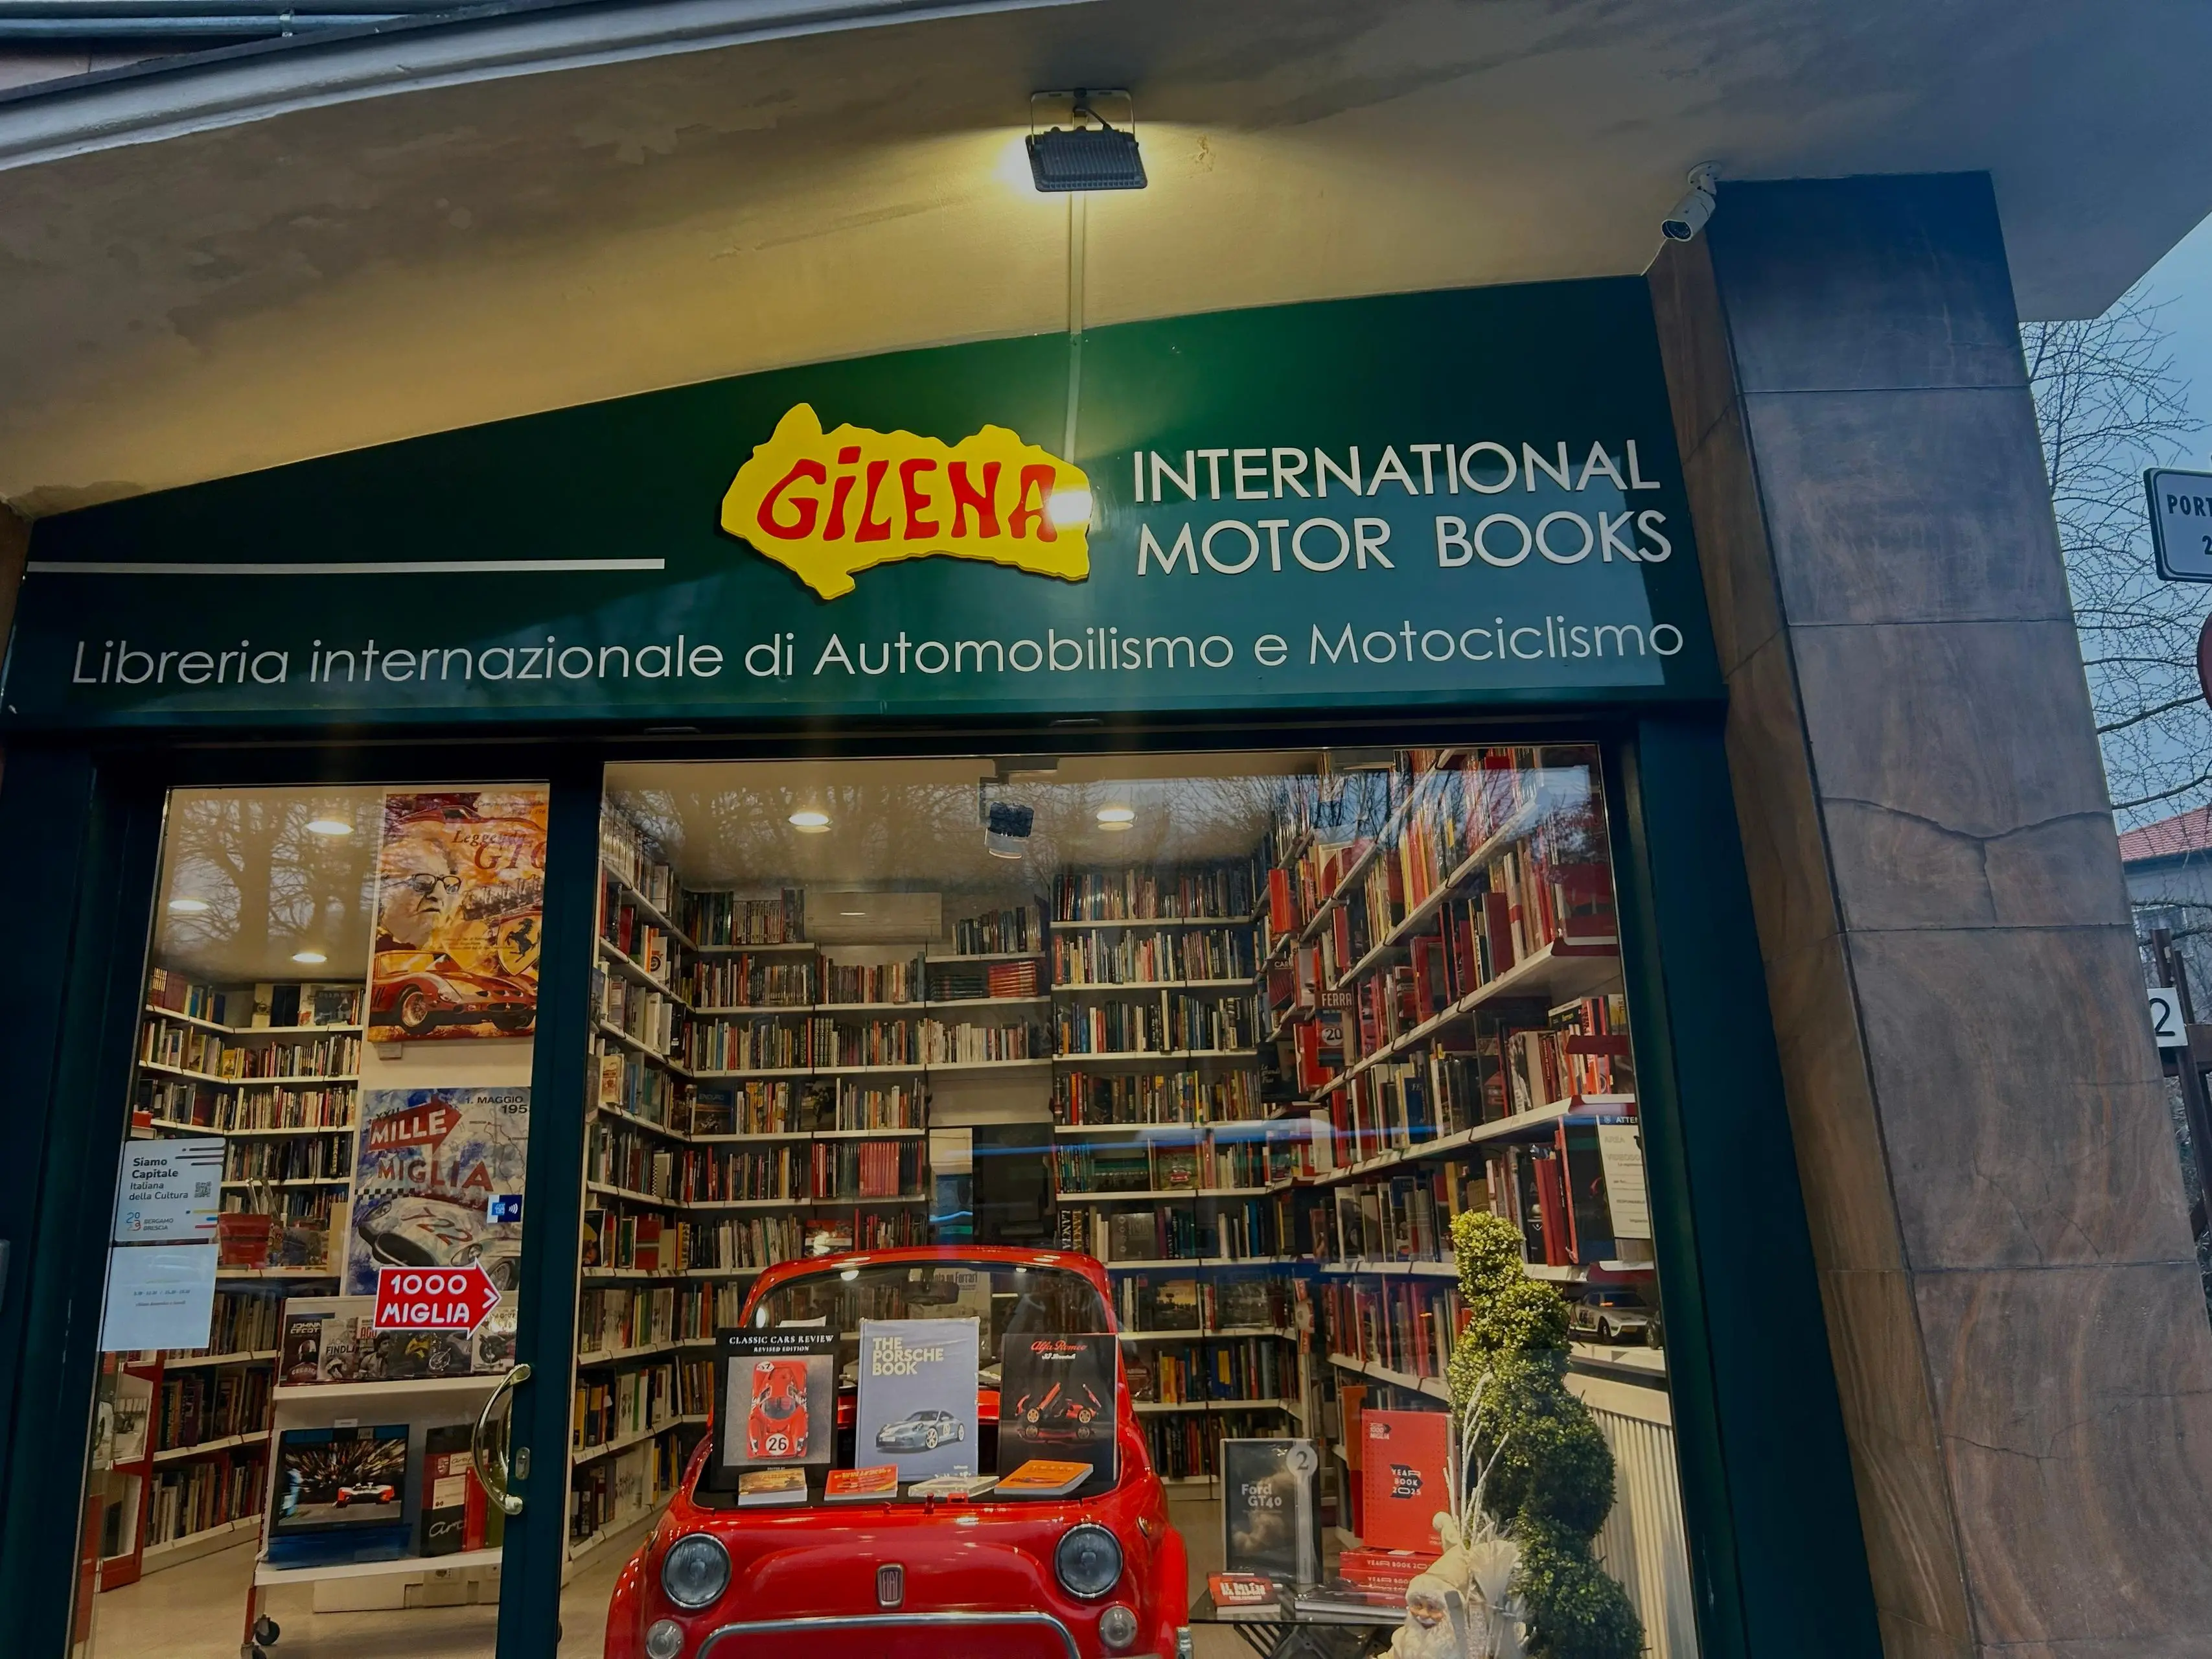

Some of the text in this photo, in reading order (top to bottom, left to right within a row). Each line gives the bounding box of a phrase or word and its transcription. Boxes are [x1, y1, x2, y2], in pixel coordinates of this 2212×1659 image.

[1134, 439, 1661, 503] INTERNATIONAL
[1138, 510, 1672, 576] MOTOR BOOKS
[73, 616, 1683, 684] Libreria internazionale di Automobilismo e Motociclismo
[2149, 997, 2176, 1037] 2
[501, 1104, 528, 1114] 195
[371, 1109, 447, 1145] MILLE
[133, 1157, 167, 1166] Siamo
[132, 1169, 178, 1180] Capitale
[378, 1157, 494, 1192] MIGLIA
[130, 1181, 164, 1190] Italiana
[129, 1190, 188, 1200] della Cultura
[1062, 1210, 1071, 1249] LANCIA
[390, 1274, 467, 1295] 1000
[380, 1302, 470, 1324] MIGLIA
[729, 1334, 835, 1345] CLASSIC CARS REVIEW
[872, 1336, 903, 1350] THE
[1031, 1340, 1088, 1354] Alfa Romeo
[872, 1348, 944, 1363] PORSCHE
[872, 1361, 917, 1376] BOOK
[768, 1437, 787, 1451] 26
[1296, 1450, 1309, 1471] 2
[1241, 1483, 1272, 1496] Ford
[1394, 1478, 1418, 1486] BOOK
[1248, 1495, 1282, 1507] GT40
[882, 1570, 899, 1601] FIAT
